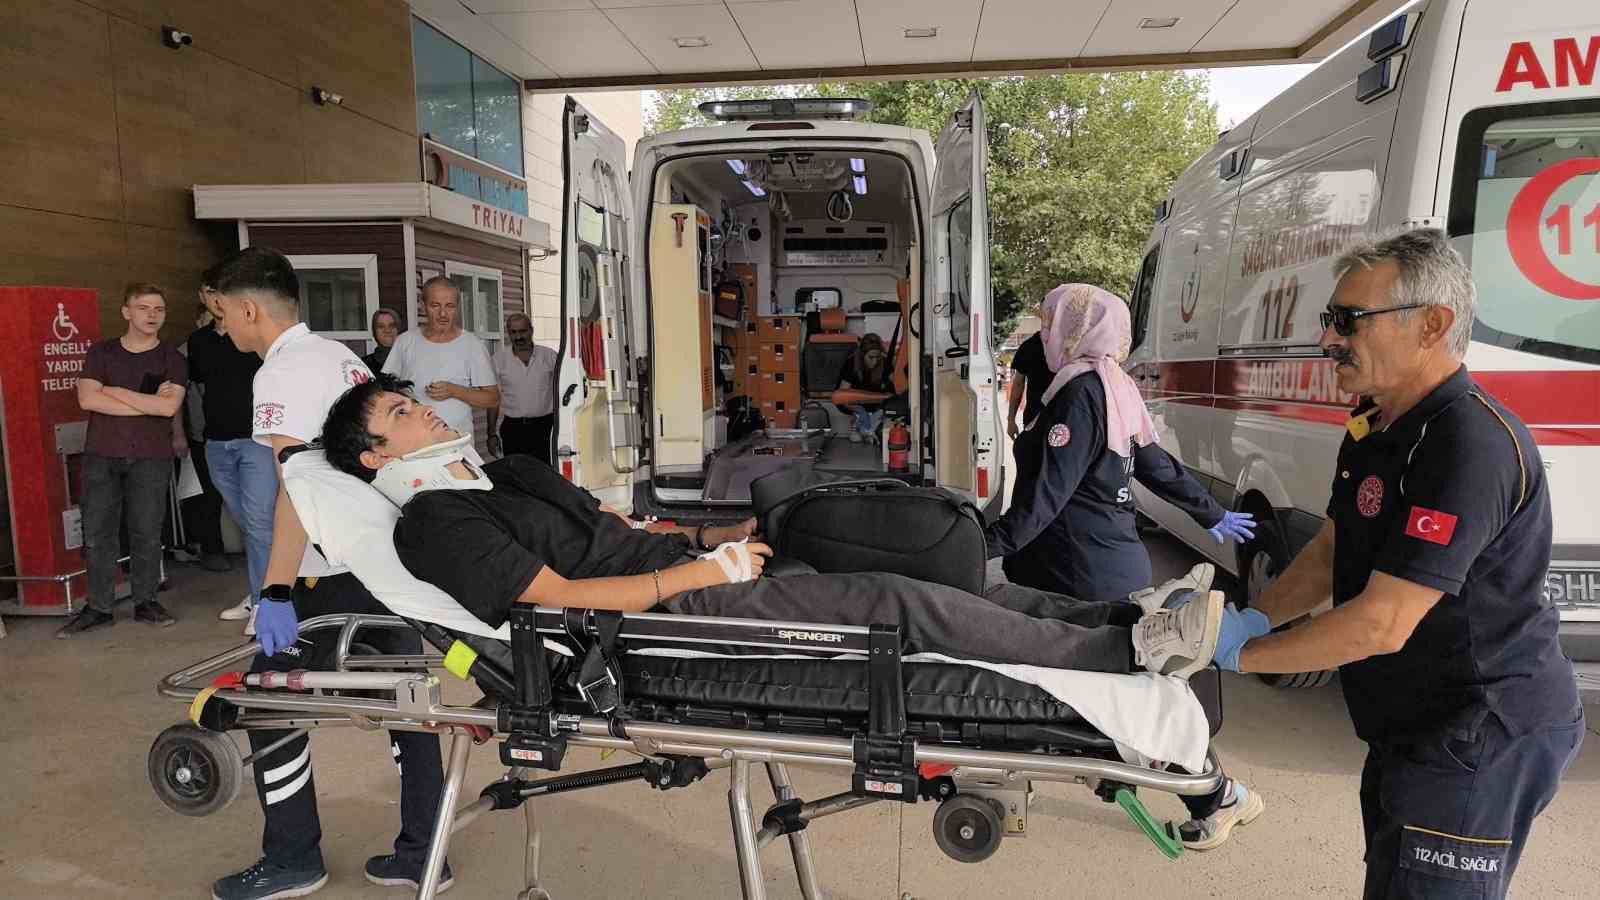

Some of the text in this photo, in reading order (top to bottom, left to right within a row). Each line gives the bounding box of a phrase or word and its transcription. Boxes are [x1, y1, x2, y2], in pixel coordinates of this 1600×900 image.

[1262, 275, 1298, 339] 112
[46, 359, 86, 373] YARDI
[41, 377, 80, 391] TELEF
[1248, 361, 1359, 405] AMBULAN
[778, 630, 842, 643] SPENCER
